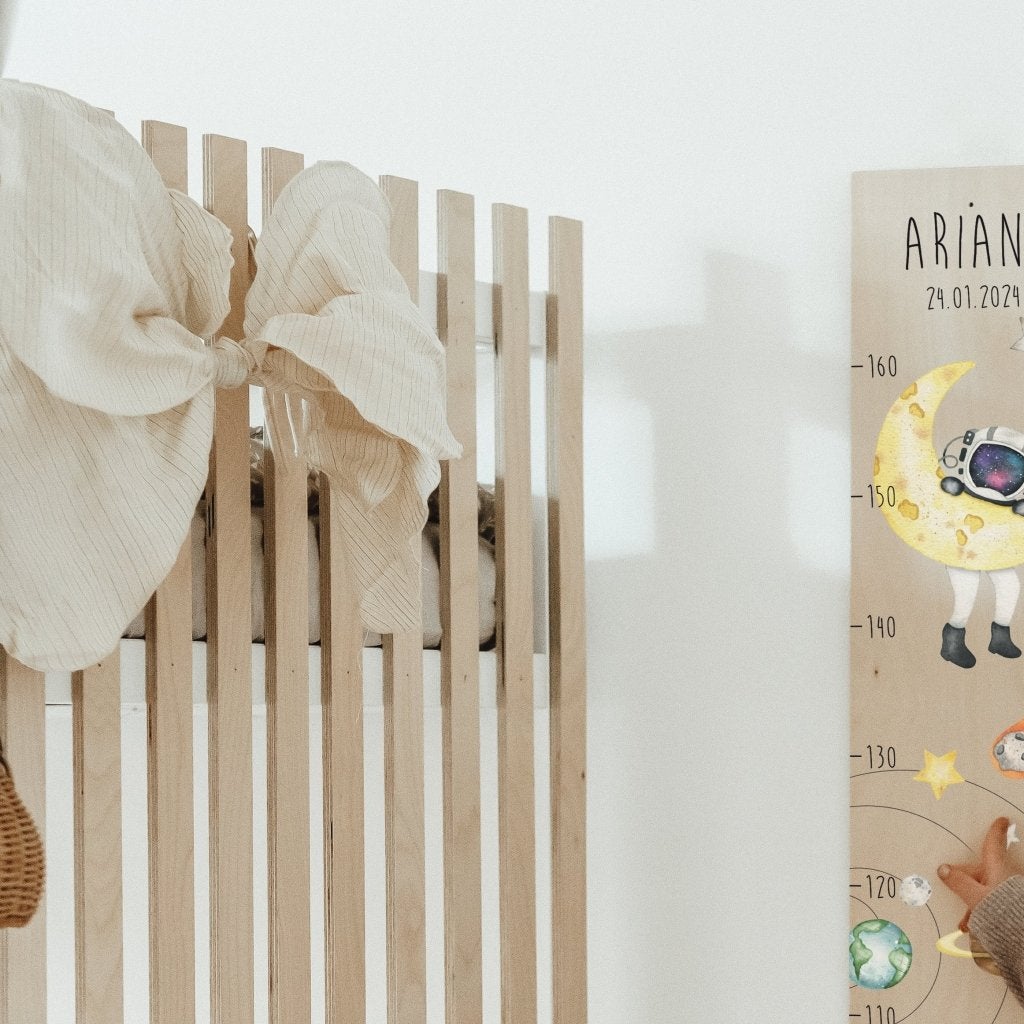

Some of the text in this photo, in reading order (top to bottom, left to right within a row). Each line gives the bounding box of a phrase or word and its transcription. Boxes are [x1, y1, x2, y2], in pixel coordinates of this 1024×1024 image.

[926, 283, 1021, 311] 24.01.2024
[867, 353, 898, 379] 160
[867, 483, 897, 509] 150
[866, 614, 897, 639] 140
[866, 744, 897, 769] 130
[866, 874, 897, 899] 120
